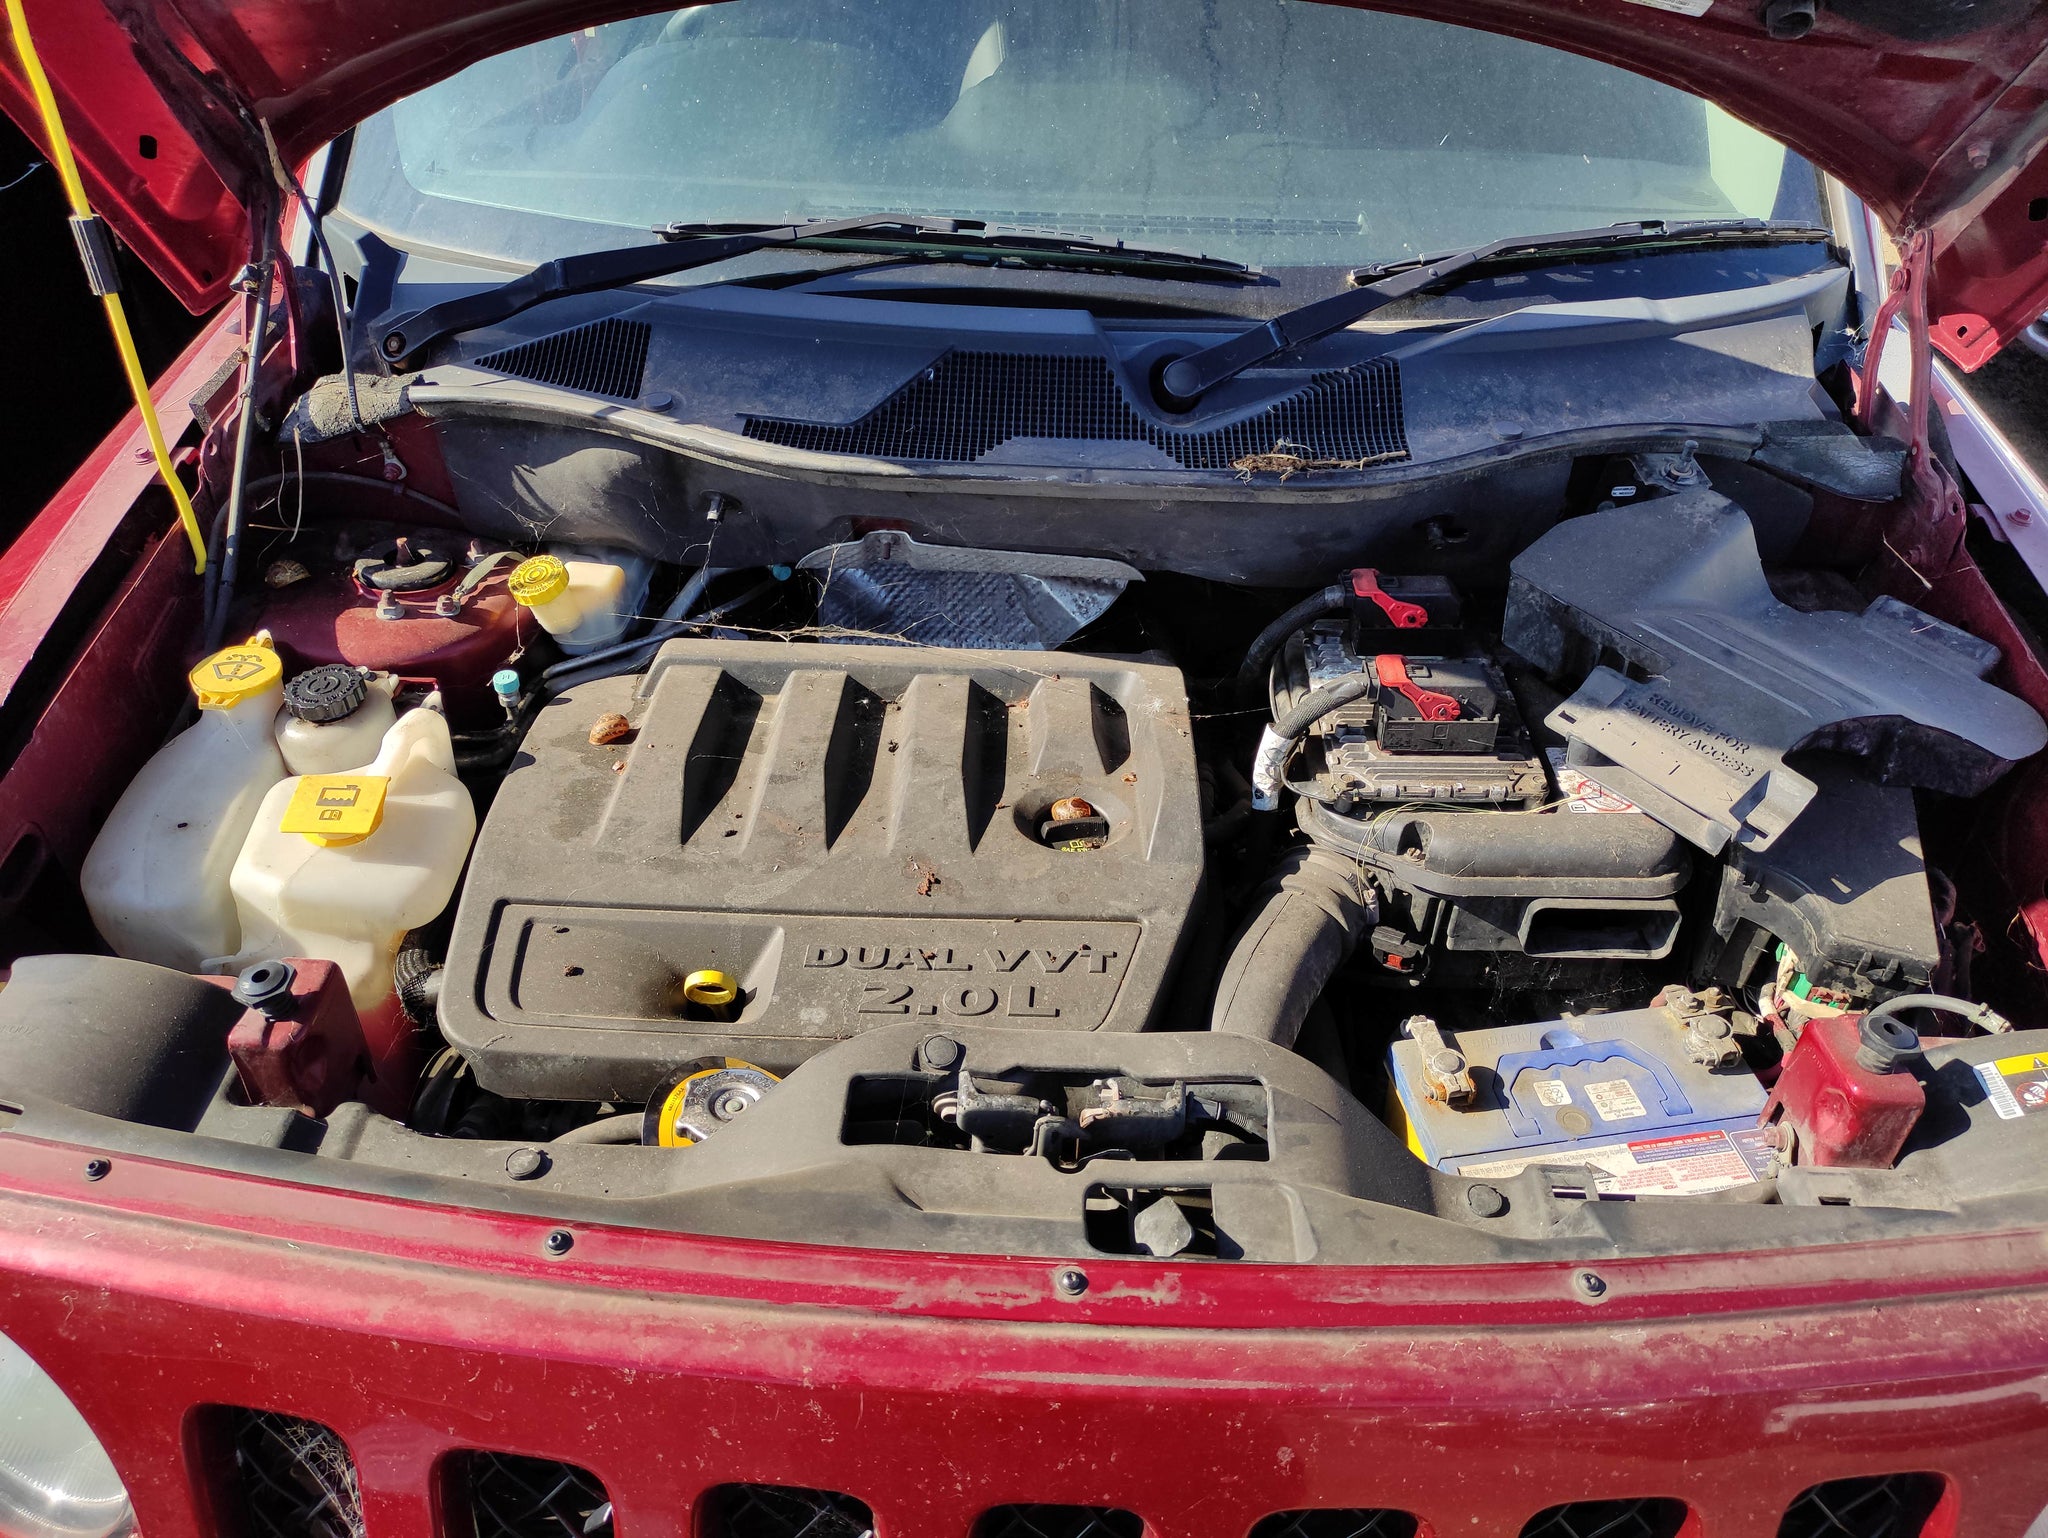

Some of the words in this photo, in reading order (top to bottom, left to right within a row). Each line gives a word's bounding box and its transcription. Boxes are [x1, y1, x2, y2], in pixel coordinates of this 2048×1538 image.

[1622, 699, 1691, 740] BATTERY
[1687, 739, 1755, 777] ACCESS
[1648, 692, 1715, 734] REMOVE
[1714, 731, 1751, 755] FOR
[803, 945, 974, 972] DUAL
[984, 947, 1118, 974] VVT
[858, 982, 1061, 1018] 2.0L
